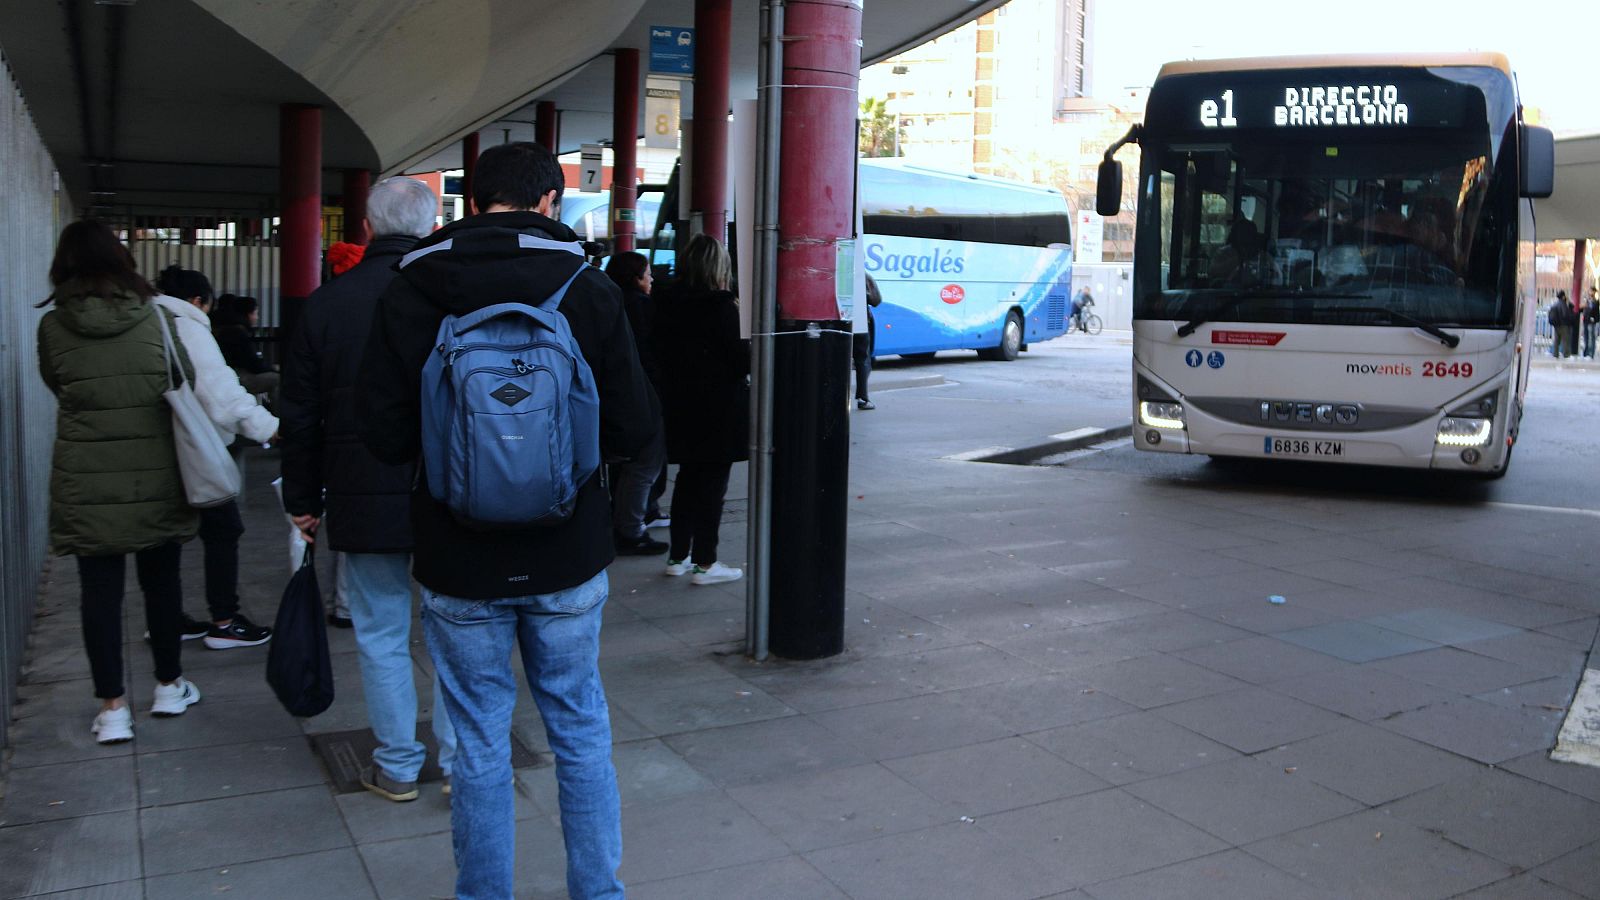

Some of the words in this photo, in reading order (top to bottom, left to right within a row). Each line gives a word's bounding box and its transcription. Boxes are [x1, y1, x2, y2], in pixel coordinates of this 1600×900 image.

[1286, 85, 1398, 106] DIRECCIO
[1200, 89, 1237, 127] e1
[1274, 103, 1408, 126] BARCELONA
[655, 113, 669, 135] 8
[587, 169, 596, 184] 7
[445, 212, 453, 222] 5
[864, 242, 965, 279] Sagalés
[1346, 363, 1412, 376] moventis
[1422, 361, 1473, 378] 2649
[1261, 402, 1358, 425] IVECO
[1274, 440, 1309, 454] 6836
[1315, 442, 1342, 456] KZM
